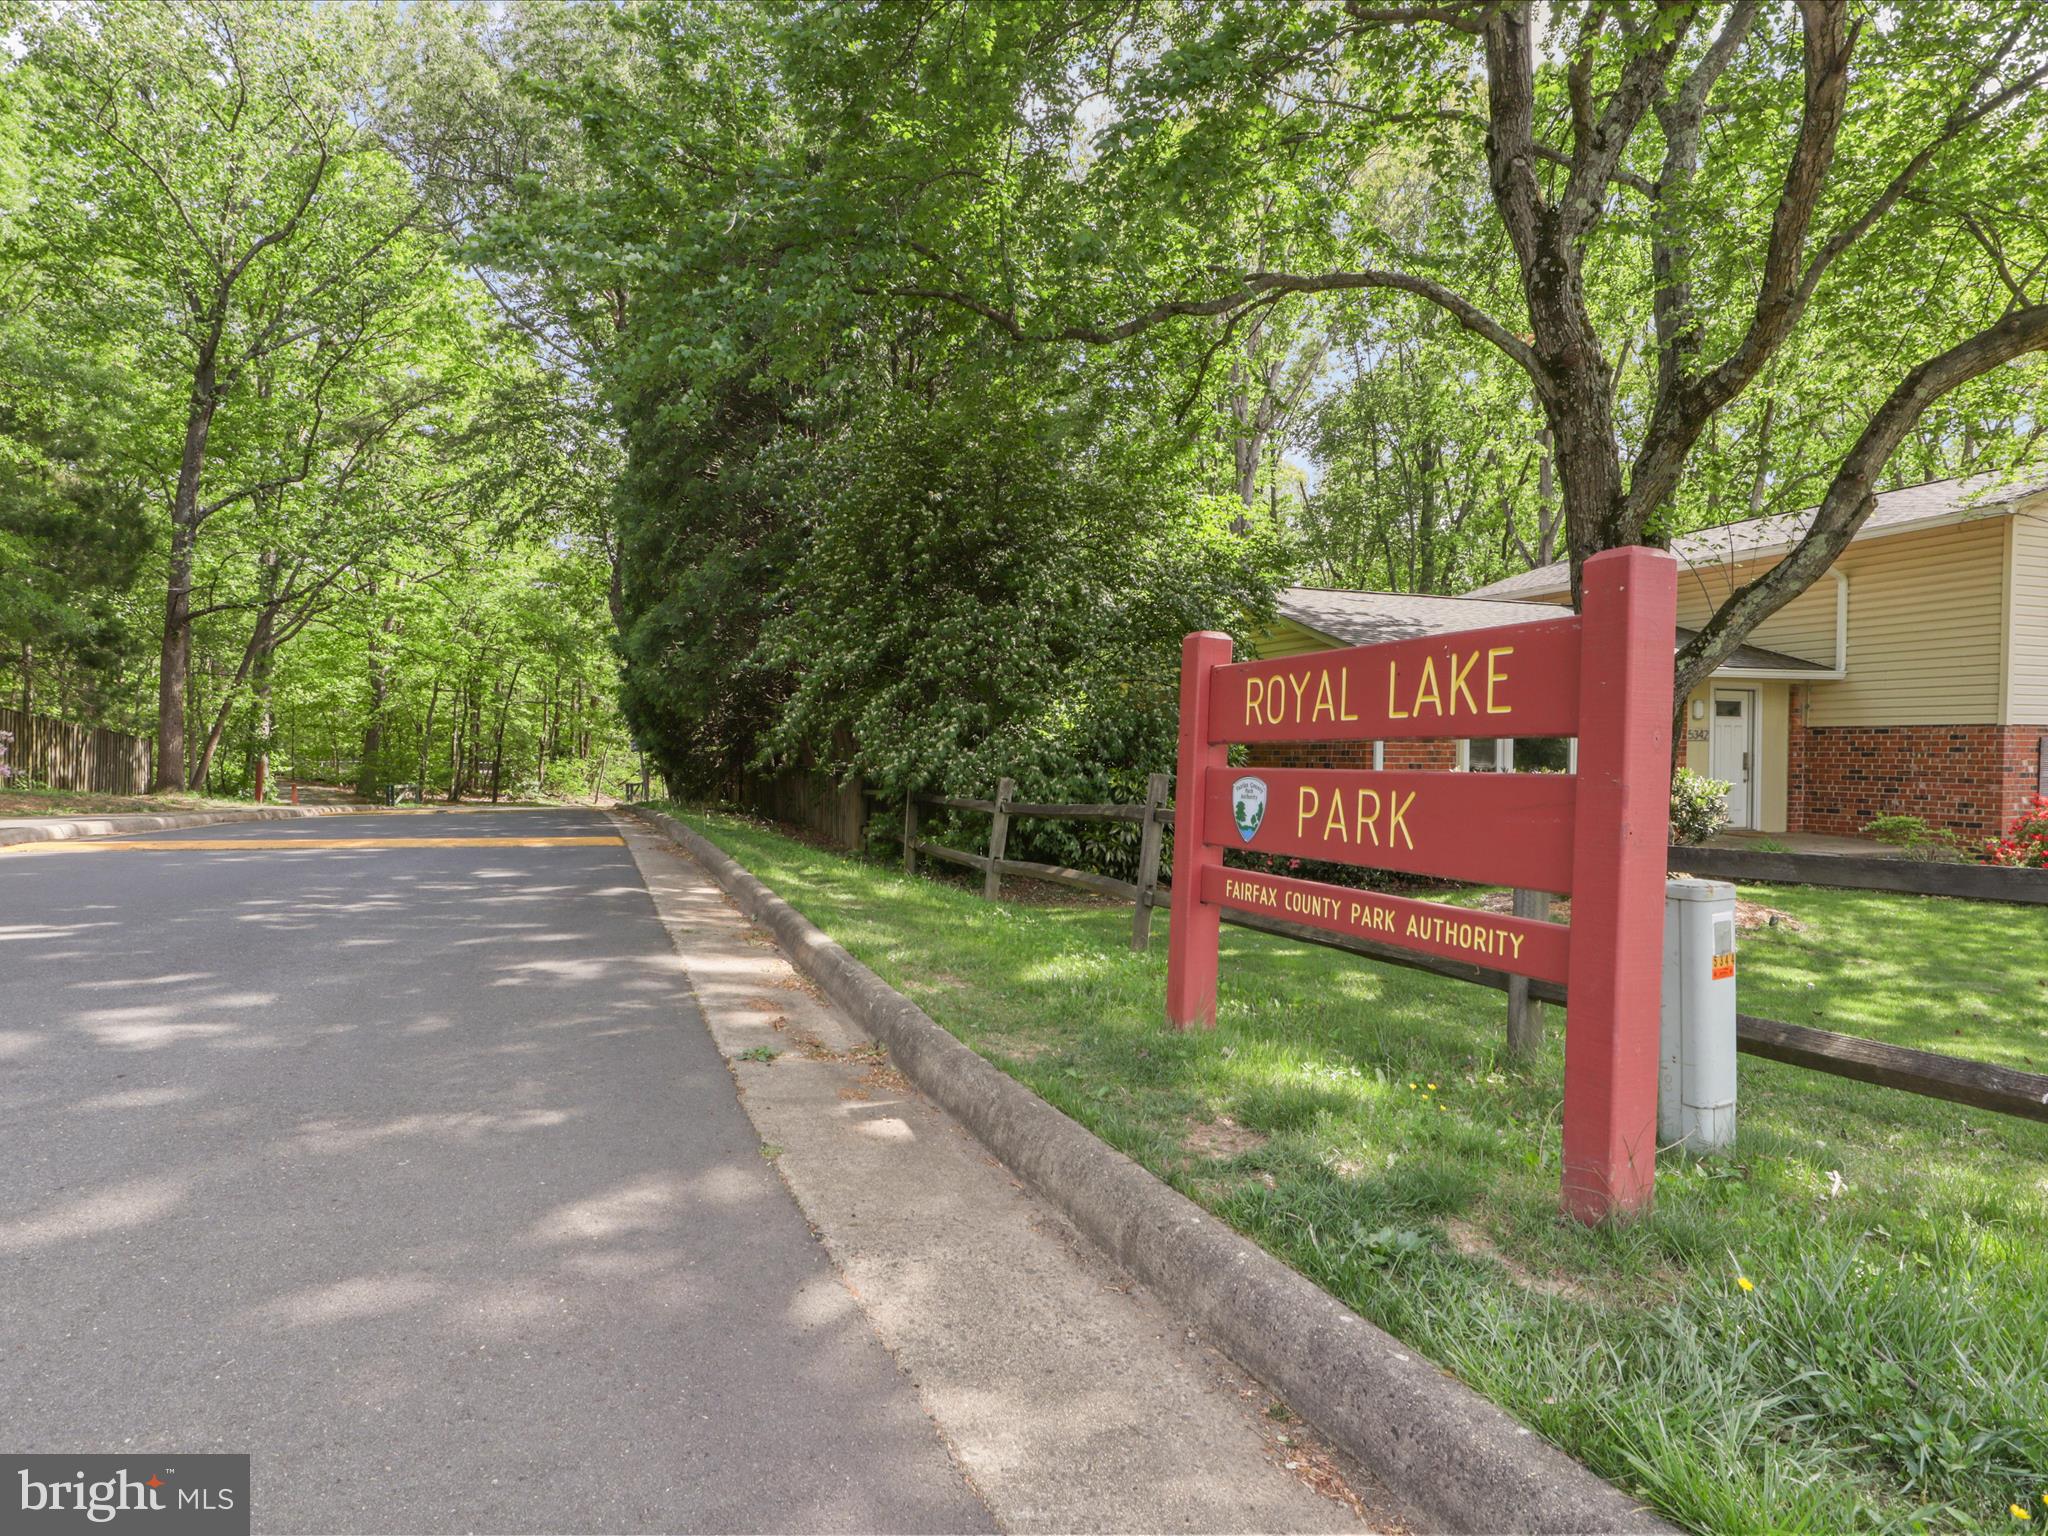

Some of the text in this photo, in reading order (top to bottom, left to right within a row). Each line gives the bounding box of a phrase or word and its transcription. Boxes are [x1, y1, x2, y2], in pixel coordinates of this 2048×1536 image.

[1245, 646, 1514, 726] ROYAL LAKE
[1297, 785, 1416, 850] PARK
[1225, 880, 1525, 959] FAIRFAX COUNTY PARK AUTHORITY
